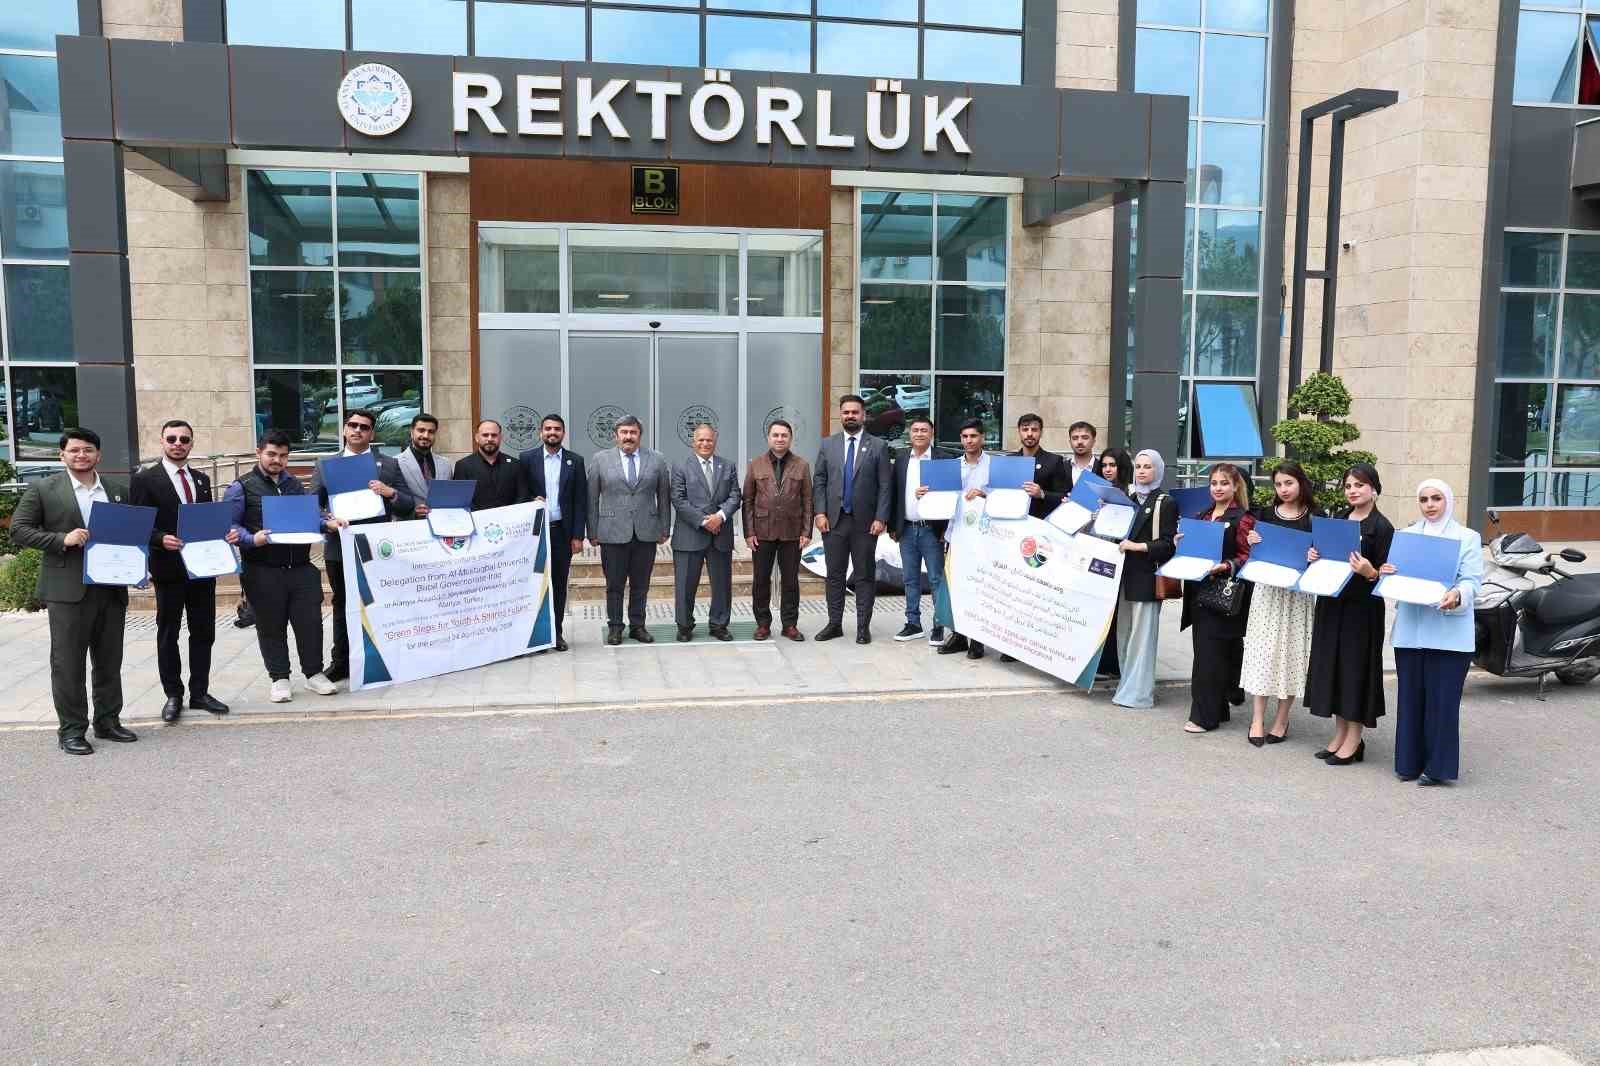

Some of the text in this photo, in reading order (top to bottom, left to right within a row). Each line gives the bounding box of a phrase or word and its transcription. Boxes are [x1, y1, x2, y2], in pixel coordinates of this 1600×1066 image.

[453, 68, 973, 154] REKTÖRLÜK
[644, 170, 666, 193] B
[635, 196, 674, 209] BLOK
[381, 575, 426, 588] Delegation
[427, 573, 447, 581] from
[413, 624, 436, 635] Steps
[438, 623, 448, 631] for
[450, 615, 472, 626] Youth
